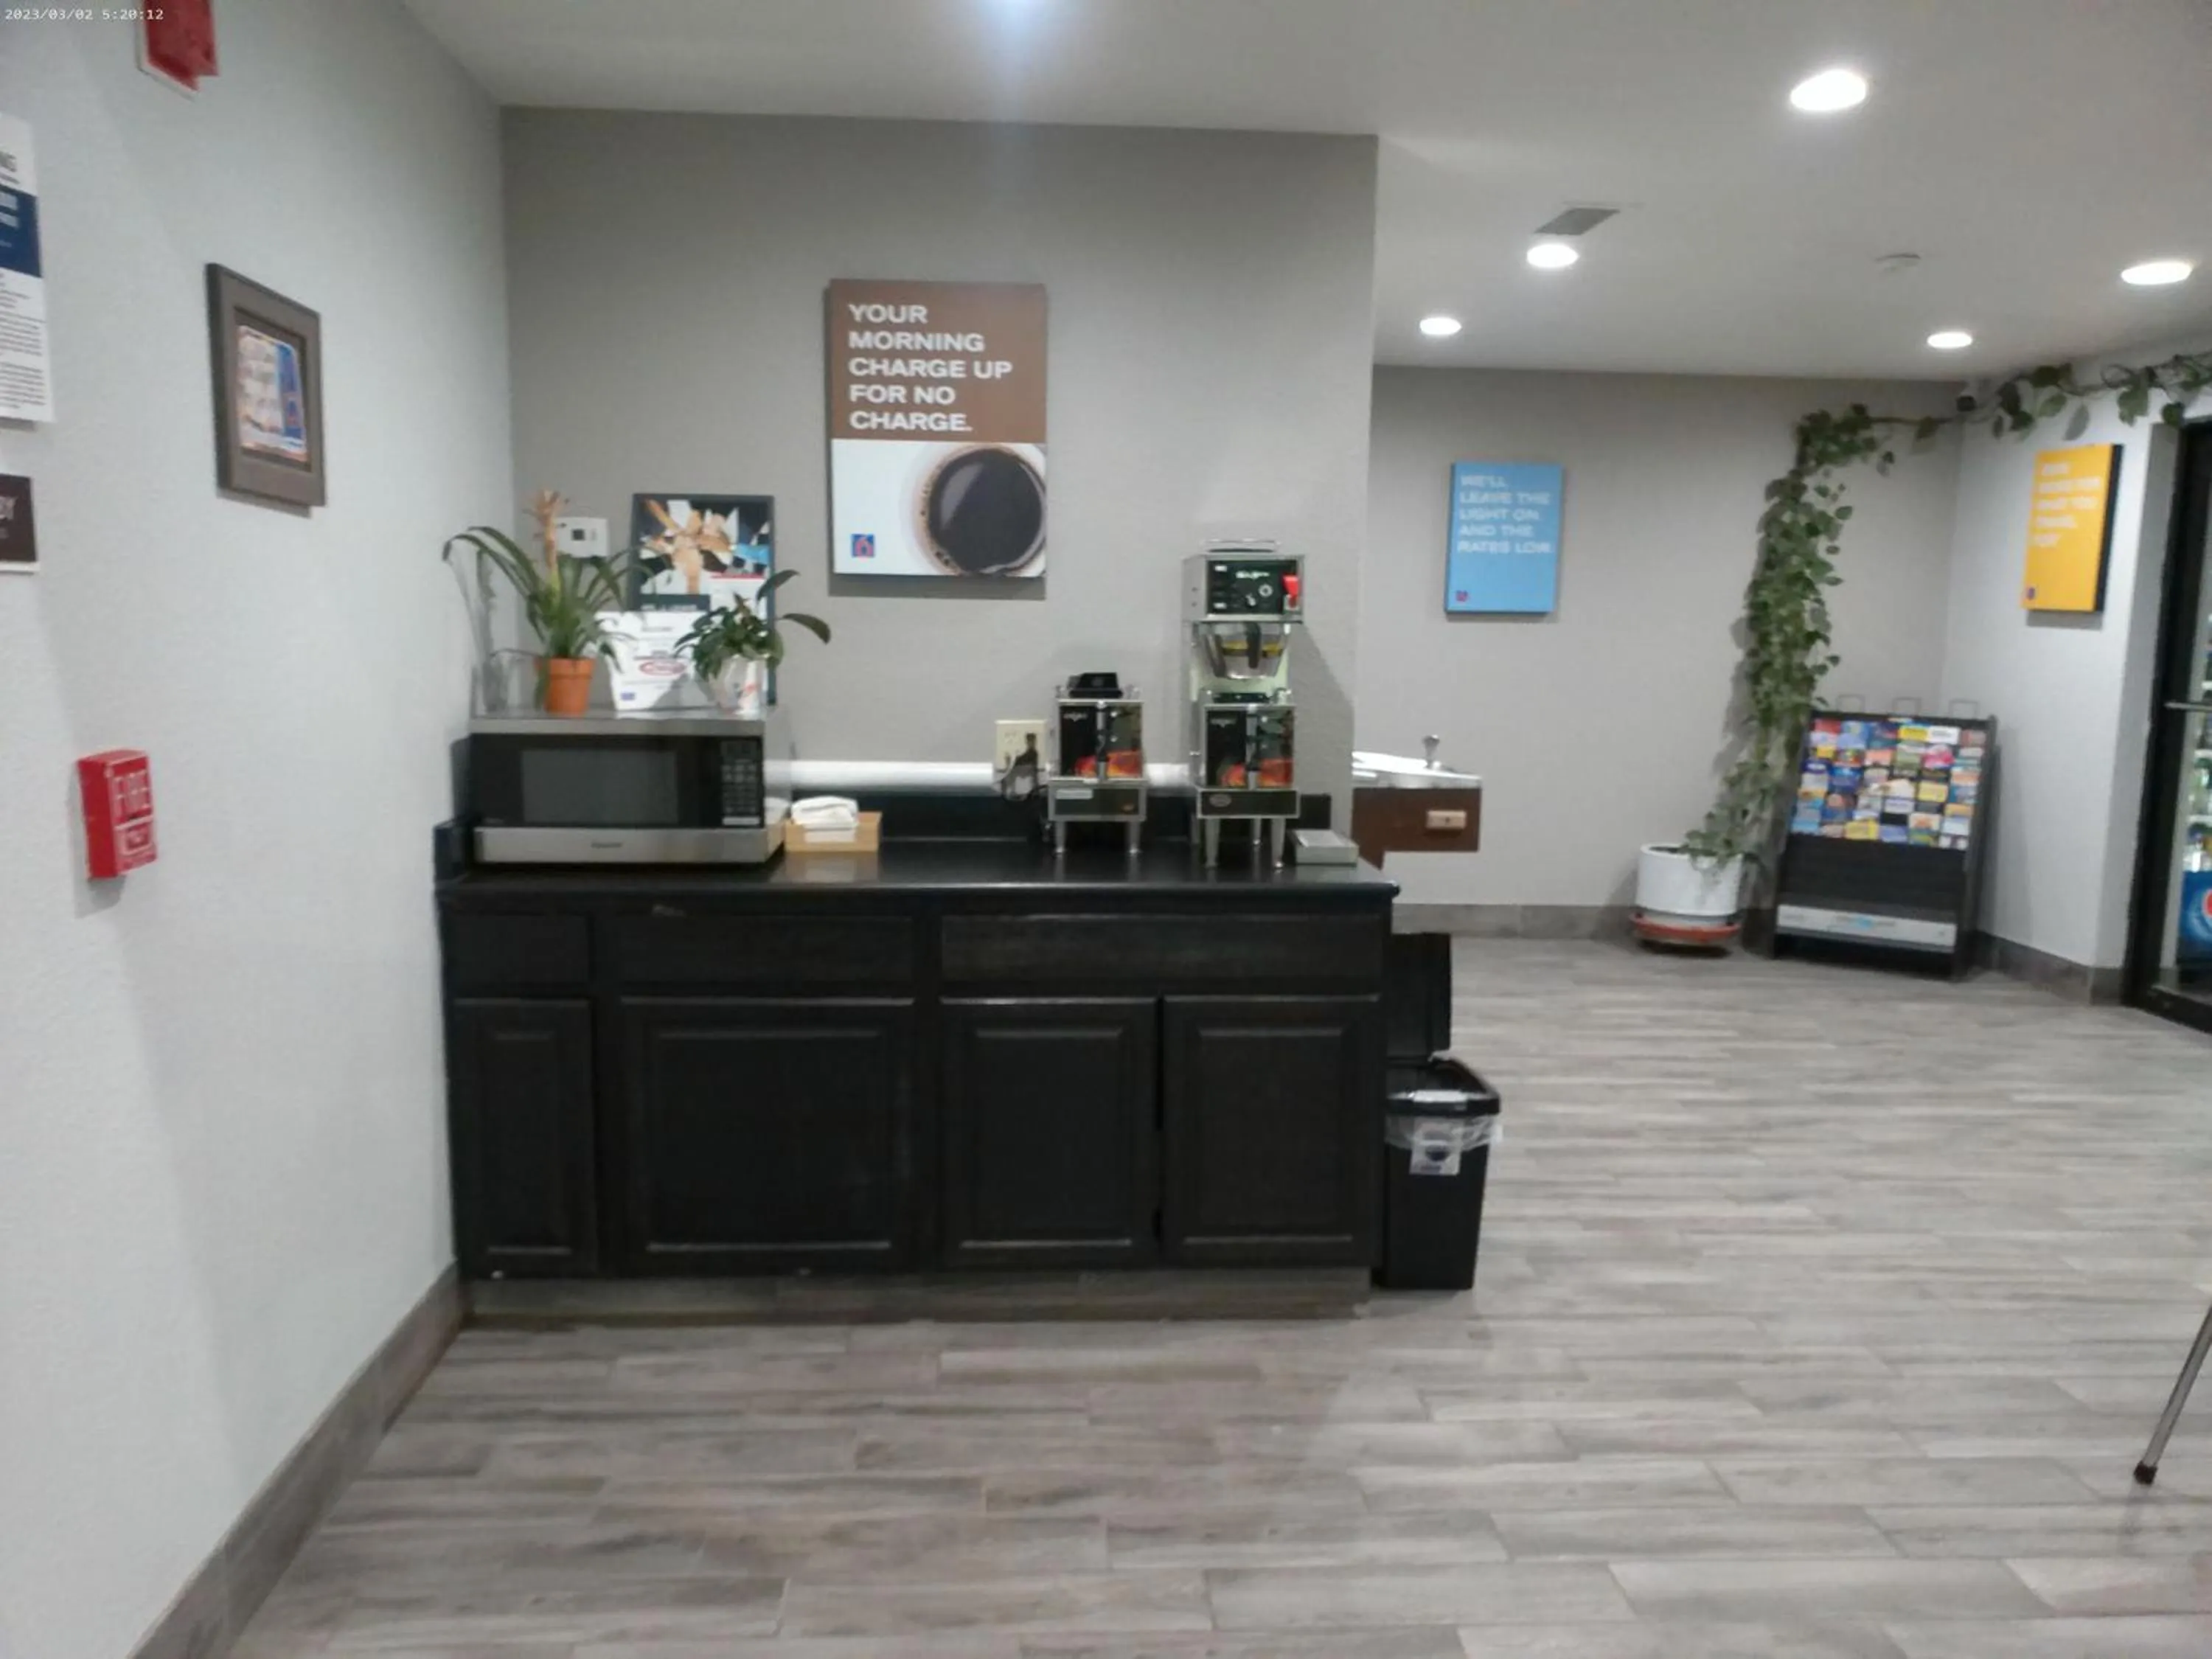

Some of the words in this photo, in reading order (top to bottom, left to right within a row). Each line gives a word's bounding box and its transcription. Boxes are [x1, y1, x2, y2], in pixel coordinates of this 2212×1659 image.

[848, 304, 928, 324] YOUR
[848, 331, 985, 352] MORNING
[849, 357, 967, 378] CHARGE
[973, 361, 1013, 378] UP
[849, 384, 908, 403] FOR
[913, 386, 956, 405] NO
[849, 411, 973, 431] CHARGE.
[1459, 524, 1496, 536] AND
